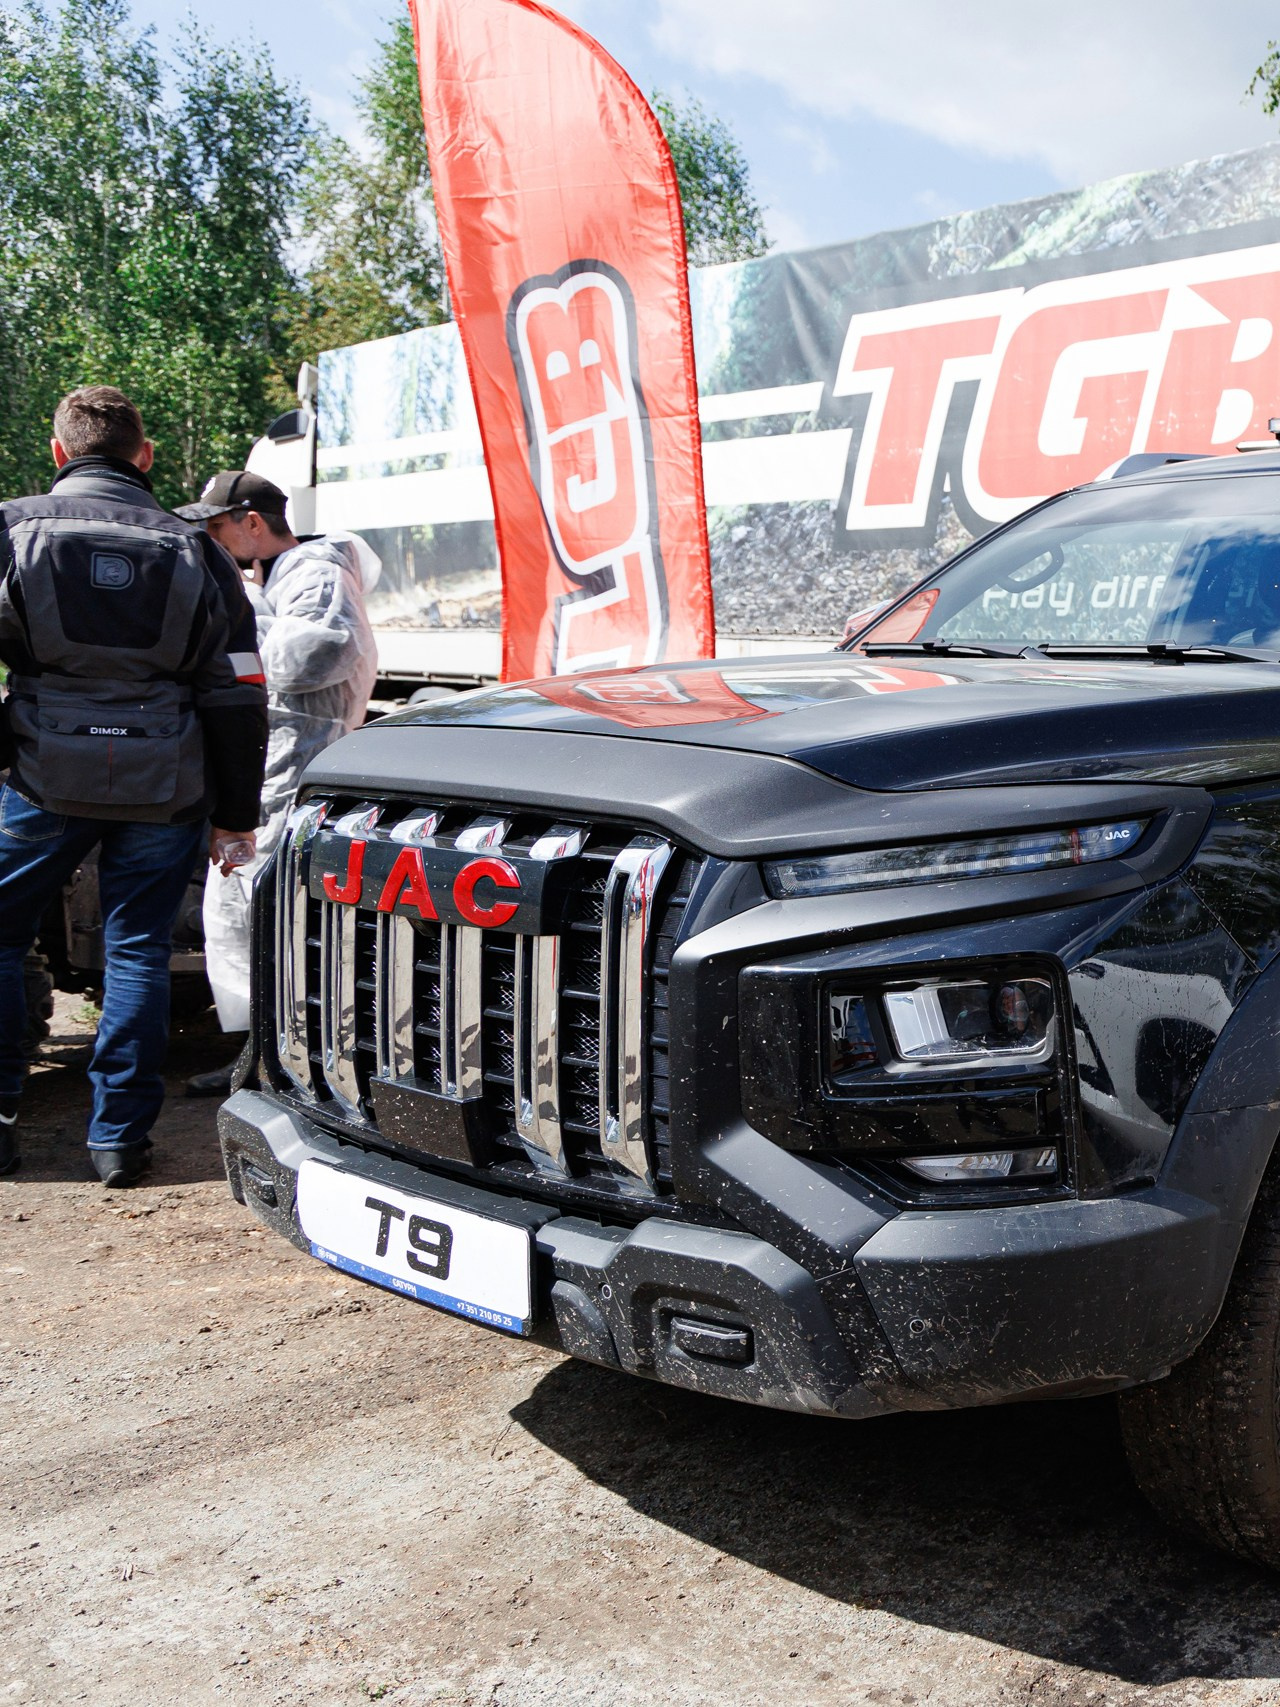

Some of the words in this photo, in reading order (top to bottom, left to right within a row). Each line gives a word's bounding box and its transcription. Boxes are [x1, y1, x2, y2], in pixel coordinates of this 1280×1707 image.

[90, 726, 128, 736] DIMOX
[1105, 829, 1131, 841] JAC
[322, 839, 522, 928] JAC
[364, 1195, 454, 1281] T9
[392, 1278, 417, 1294] САТУРН
[466, 1303, 478, 1316] 351
[479, 1307, 492, 1320] 210
[492, 1312, 502, 1323] 05
[502, 1316, 513, 1327] 25
